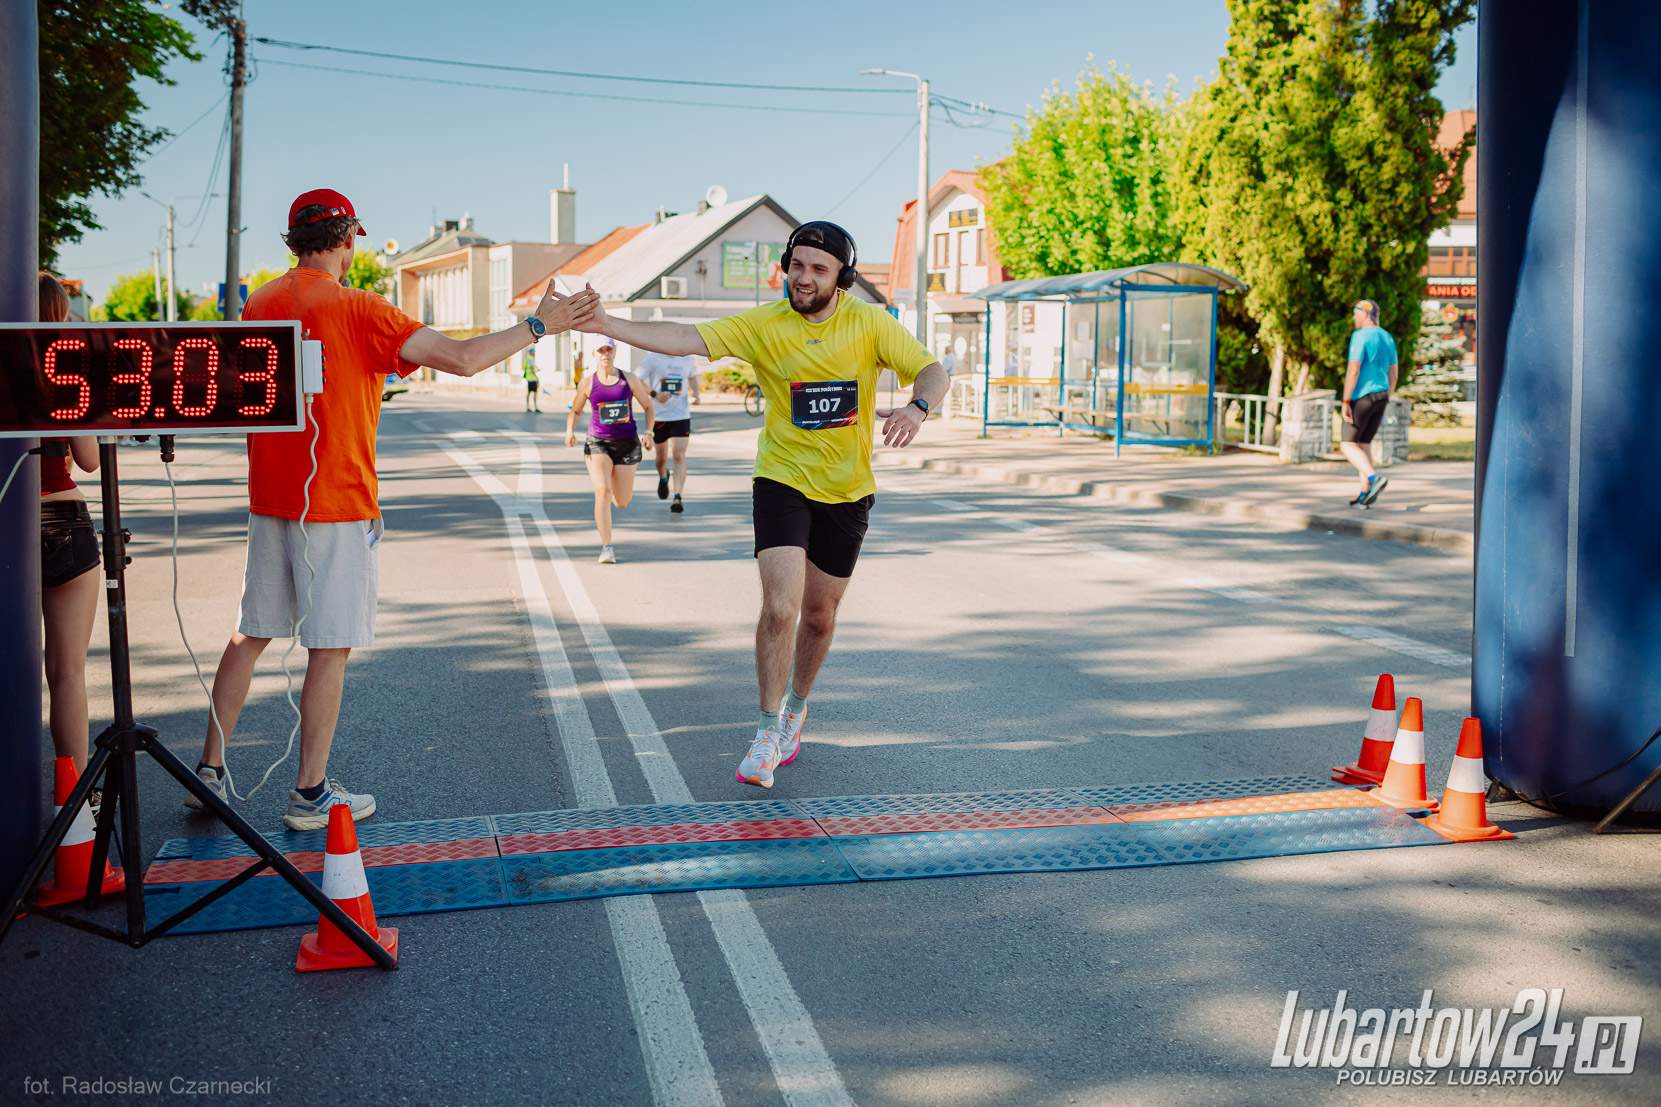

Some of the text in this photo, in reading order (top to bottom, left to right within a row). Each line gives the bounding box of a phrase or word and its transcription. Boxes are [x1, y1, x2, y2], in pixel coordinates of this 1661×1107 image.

[44, 338, 278, 420] 53.03
[608, 408, 620, 418] 37
[808, 398, 841, 414] 107
